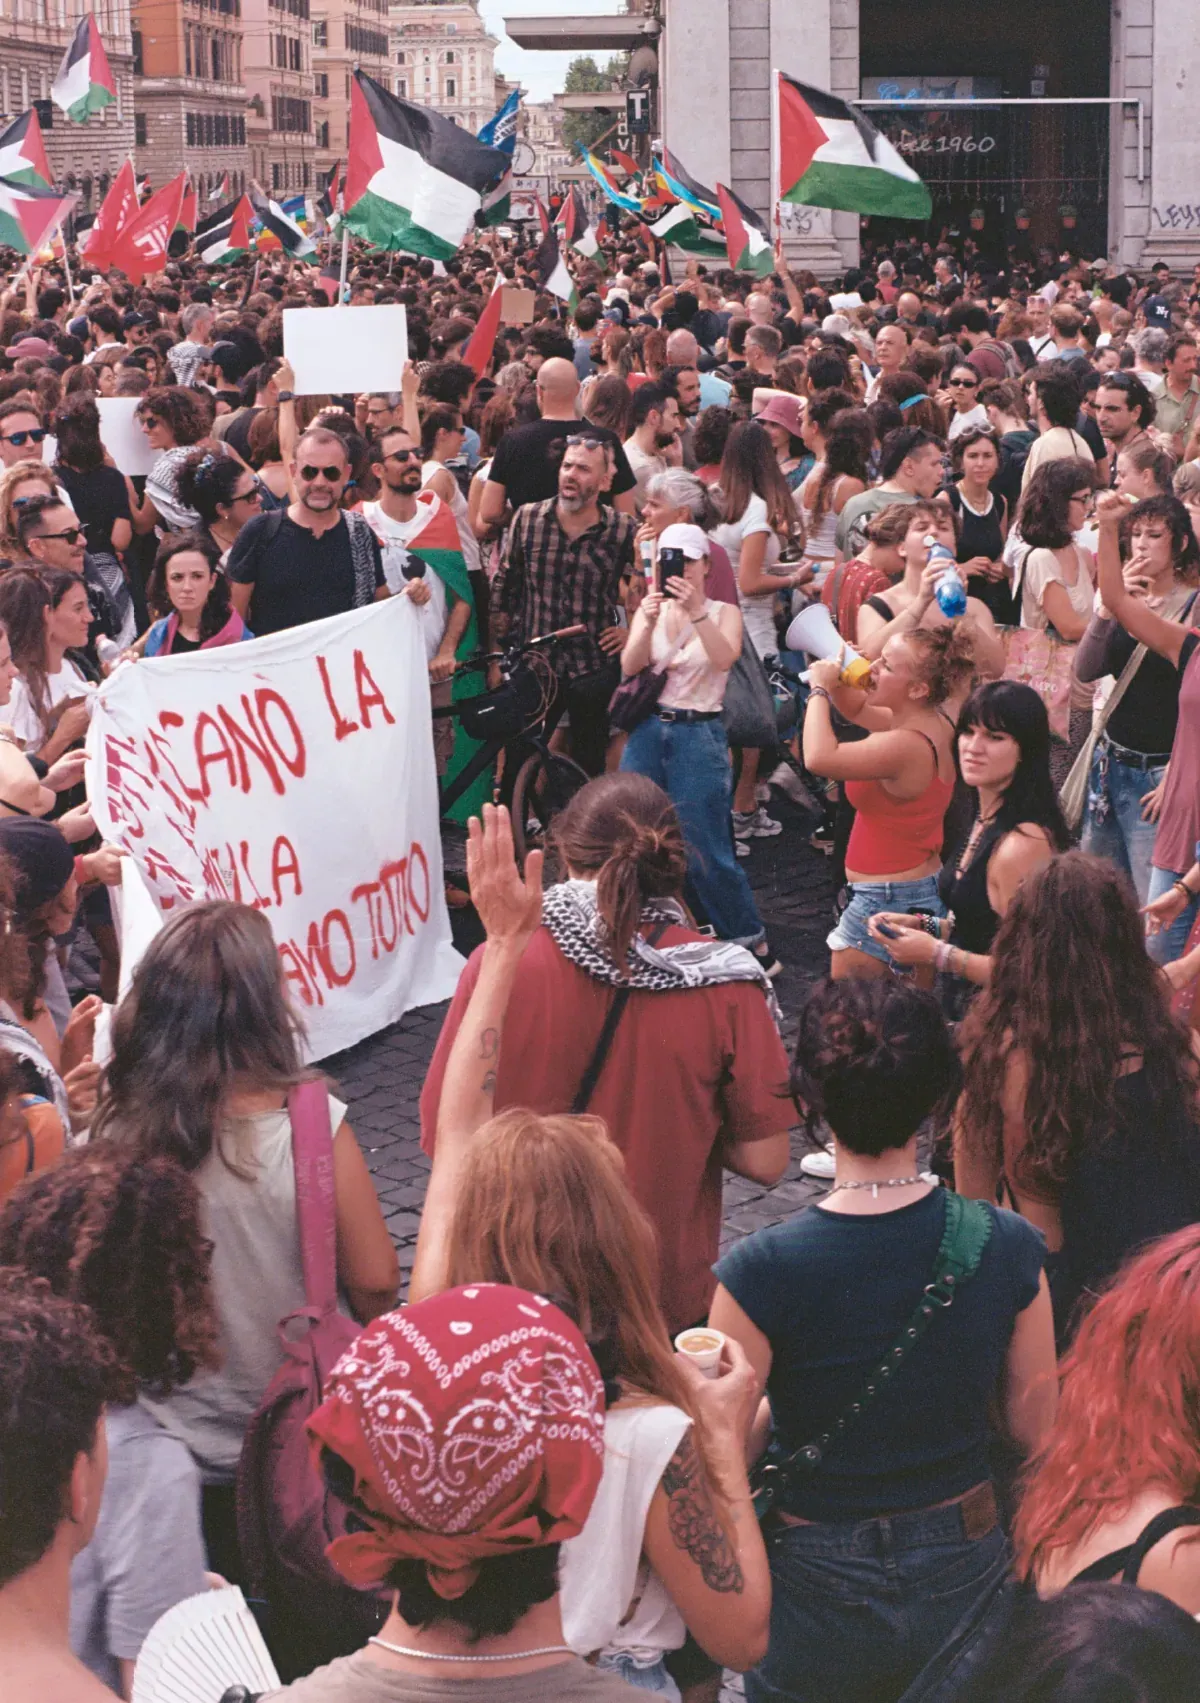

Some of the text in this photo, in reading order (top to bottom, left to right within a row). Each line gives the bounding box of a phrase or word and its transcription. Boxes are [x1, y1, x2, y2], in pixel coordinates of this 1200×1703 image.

[629, 93, 646, 119] T
[935, 135, 996, 153] 1960
[315, 647, 396, 743] LA
[280, 841, 431, 1007] AMO TUTTO
